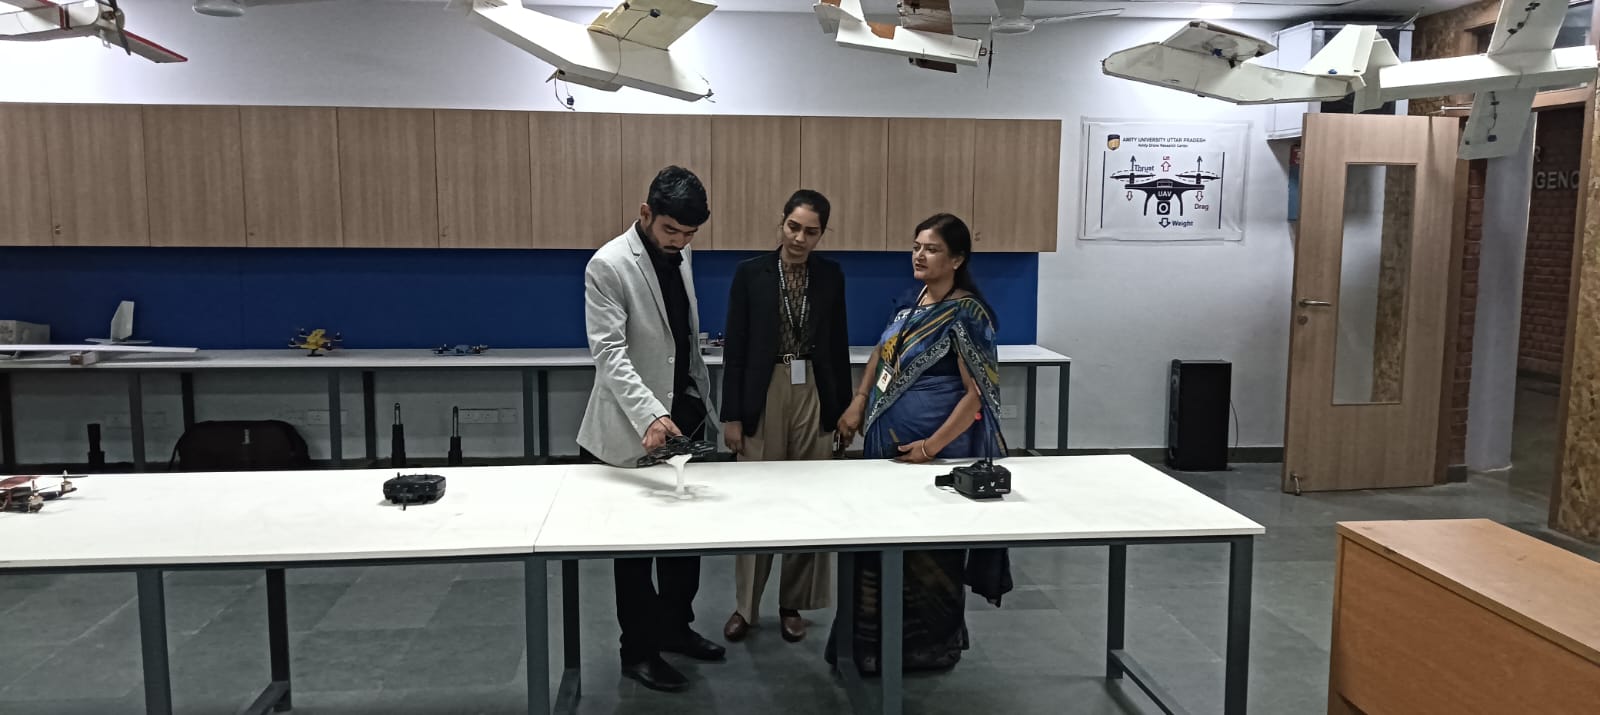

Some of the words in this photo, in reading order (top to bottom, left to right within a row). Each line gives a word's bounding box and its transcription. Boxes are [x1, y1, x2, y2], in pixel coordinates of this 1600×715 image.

[1134, 164, 1155, 172] Thrust
[1194, 203, 1209, 211] Drag
[1172, 220, 1194, 228] Weight
